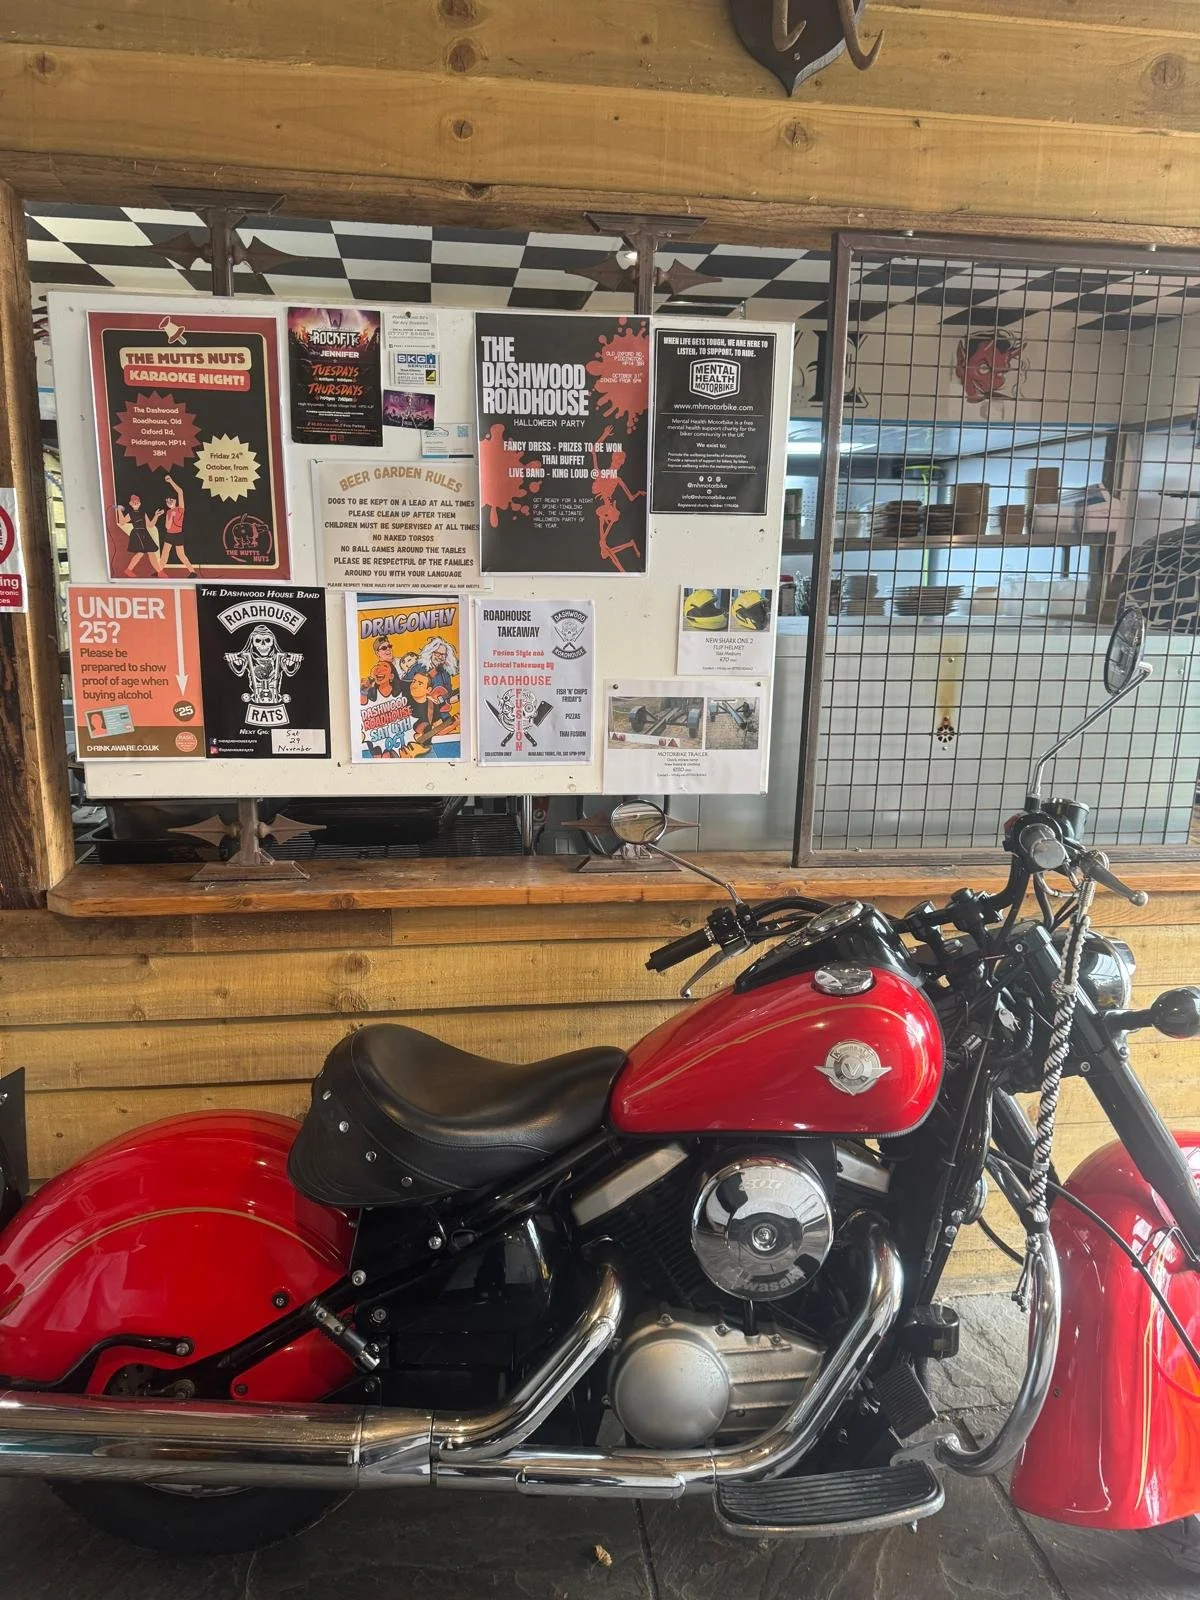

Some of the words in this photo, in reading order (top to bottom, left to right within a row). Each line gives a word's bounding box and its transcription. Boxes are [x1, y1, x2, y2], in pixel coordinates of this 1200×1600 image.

[312, 332, 357, 346] ROCKFIT
[706, 338, 726, 346] TOUGH,
[481, 336, 515, 362] THE
[707, 348, 733, 356] SUPPORT,
[126, 353, 154, 364] THE
[157, 353, 204, 364] MUTTS
[208, 353, 245, 364] NUTS
[312, 364, 359, 377] TUESDAYS
[482, 362, 585, 390] DASHWOOD
[695, 365, 734, 375] MENTAL
[130, 370, 196, 382] KARAOKE
[199, 374, 245, 385] NIGHT!
[695, 375, 734, 383] HEALTH
[308, 383, 362, 396] THURSDAYS
[695, 383, 734, 394] MOTORBIKE
[483, 388, 589, 416] ROADHOUSE
[131, 439, 167, 447] Piddington,
[504, 441, 526, 451] FANCY
[528, 442, 551, 451] DRESS
[558, 442, 582, 452] PRIZES
[584, 442, 593, 452] TO
[595, 443, 604, 452] BE
[605, 443, 622, 452] WON
[542, 455, 557, 465] THAI
[560, 455, 584, 465] BUFFET
[339, 470, 370, 492] BEER
[374, 466, 422, 479] GARDEN
[425, 471, 463, 493] RULES
[509, 468, 524, 478] LIVE
[526, 468, 545, 478] BAND
[552, 469, 569, 478] KING
[570, 469, 588, 479] LOUD
[590, 470, 598, 479] @
[601, 470, 617, 479] 9PM
[219, 589, 265, 598] DASHWOOD
[77, 596, 165, 619] UNDER
[224, 606, 300, 626] ROADHOUSE
[484, 610, 531, 622] ROADHOUSE
[555, 610, 586, 622] DASHWOOD
[361, 607, 456, 639] DRAGONFLY
[79, 621, 120, 644] 25?
[498, 627, 540, 638] TAKEAWAY
[80, 648, 113, 658] Please
[115, 649, 127, 657] be
[81, 662, 126, 673] prepared
[140, 663, 166, 672] show
[82, 676, 108, 686] proof
[110, 677, 120, 685] of
[120, 679, 139, 687] age
[141, 677, 168, 686] when
[484, 676, 552, 686] ROADHOUSE
[83, 690, 116, 701] buying
[118, 691, 152, 700] alcohol
[362, 697, 407, 720] DASHWOOD
[252, 709, 283, 722] RATS
[364, 705, 412, 731] ROADHOUSE
[370, 726, 389, 742] SAT
[385, 733, 405, 750] OCT
